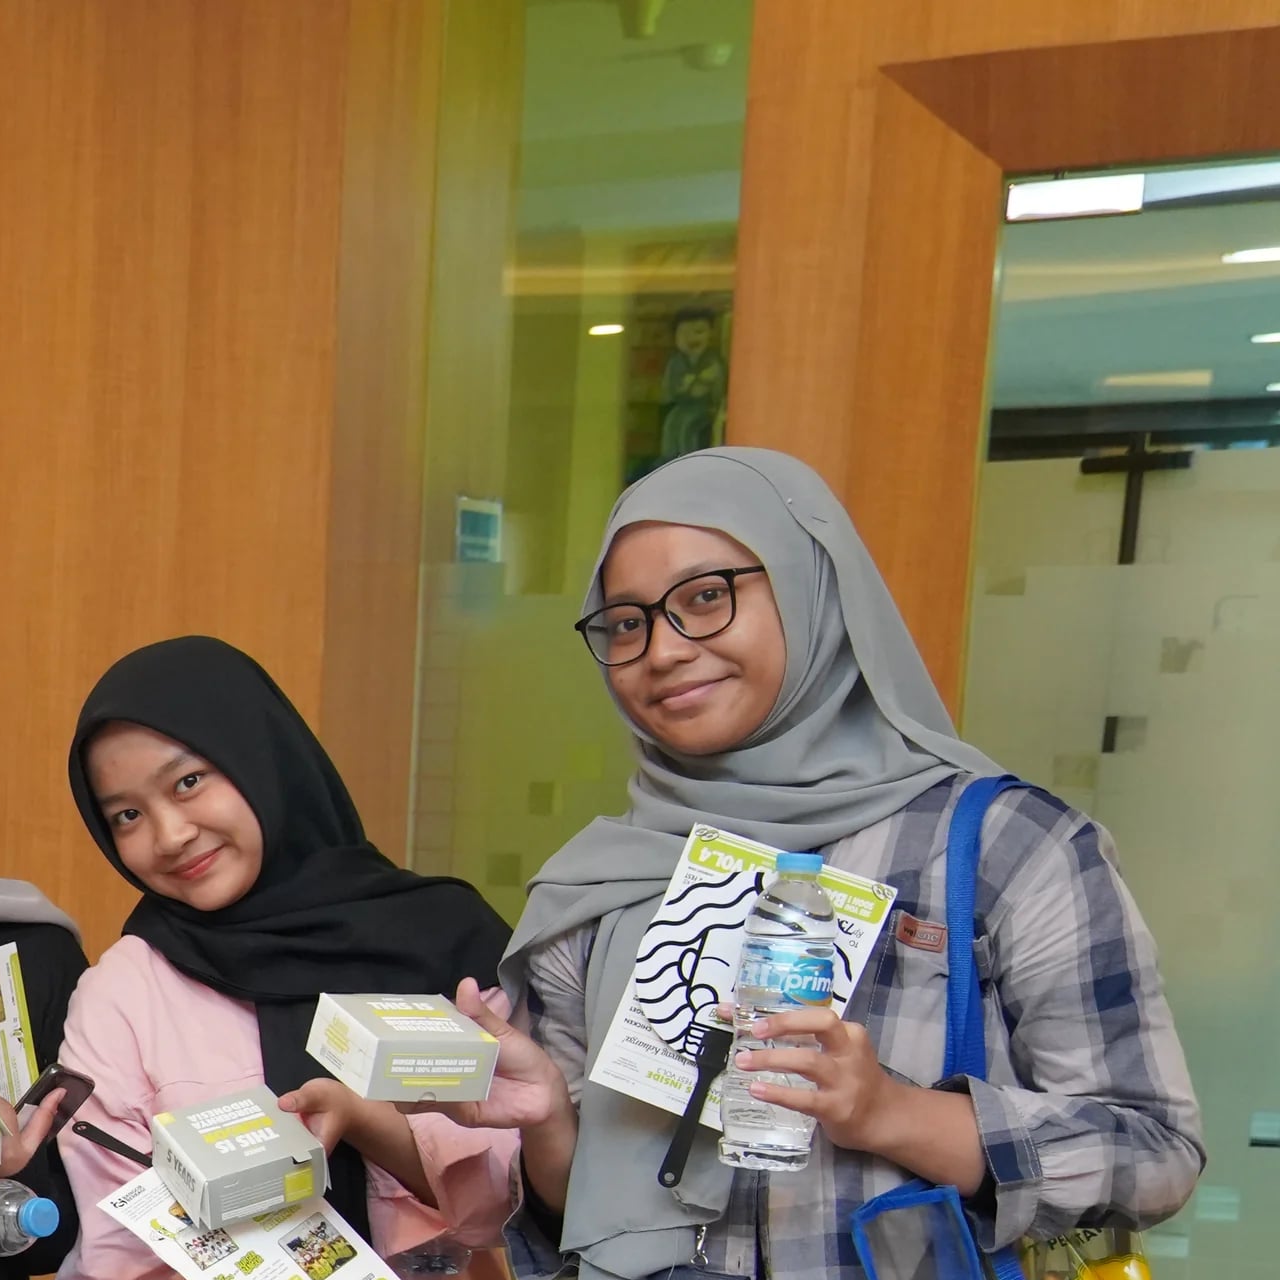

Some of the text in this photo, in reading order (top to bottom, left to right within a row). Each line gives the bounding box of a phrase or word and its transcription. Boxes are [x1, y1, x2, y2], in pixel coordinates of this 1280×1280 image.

[784, 971, 831, 993] prim
[624, 1017, 653, 1032] CHICKEN
[647, 1070, 683, 1090] INSIDE
[214, 1139, 236, 1154] IS
[235, 1127, 280, 1148] THIS
[173, 1155, 196, 1193] YEARS
